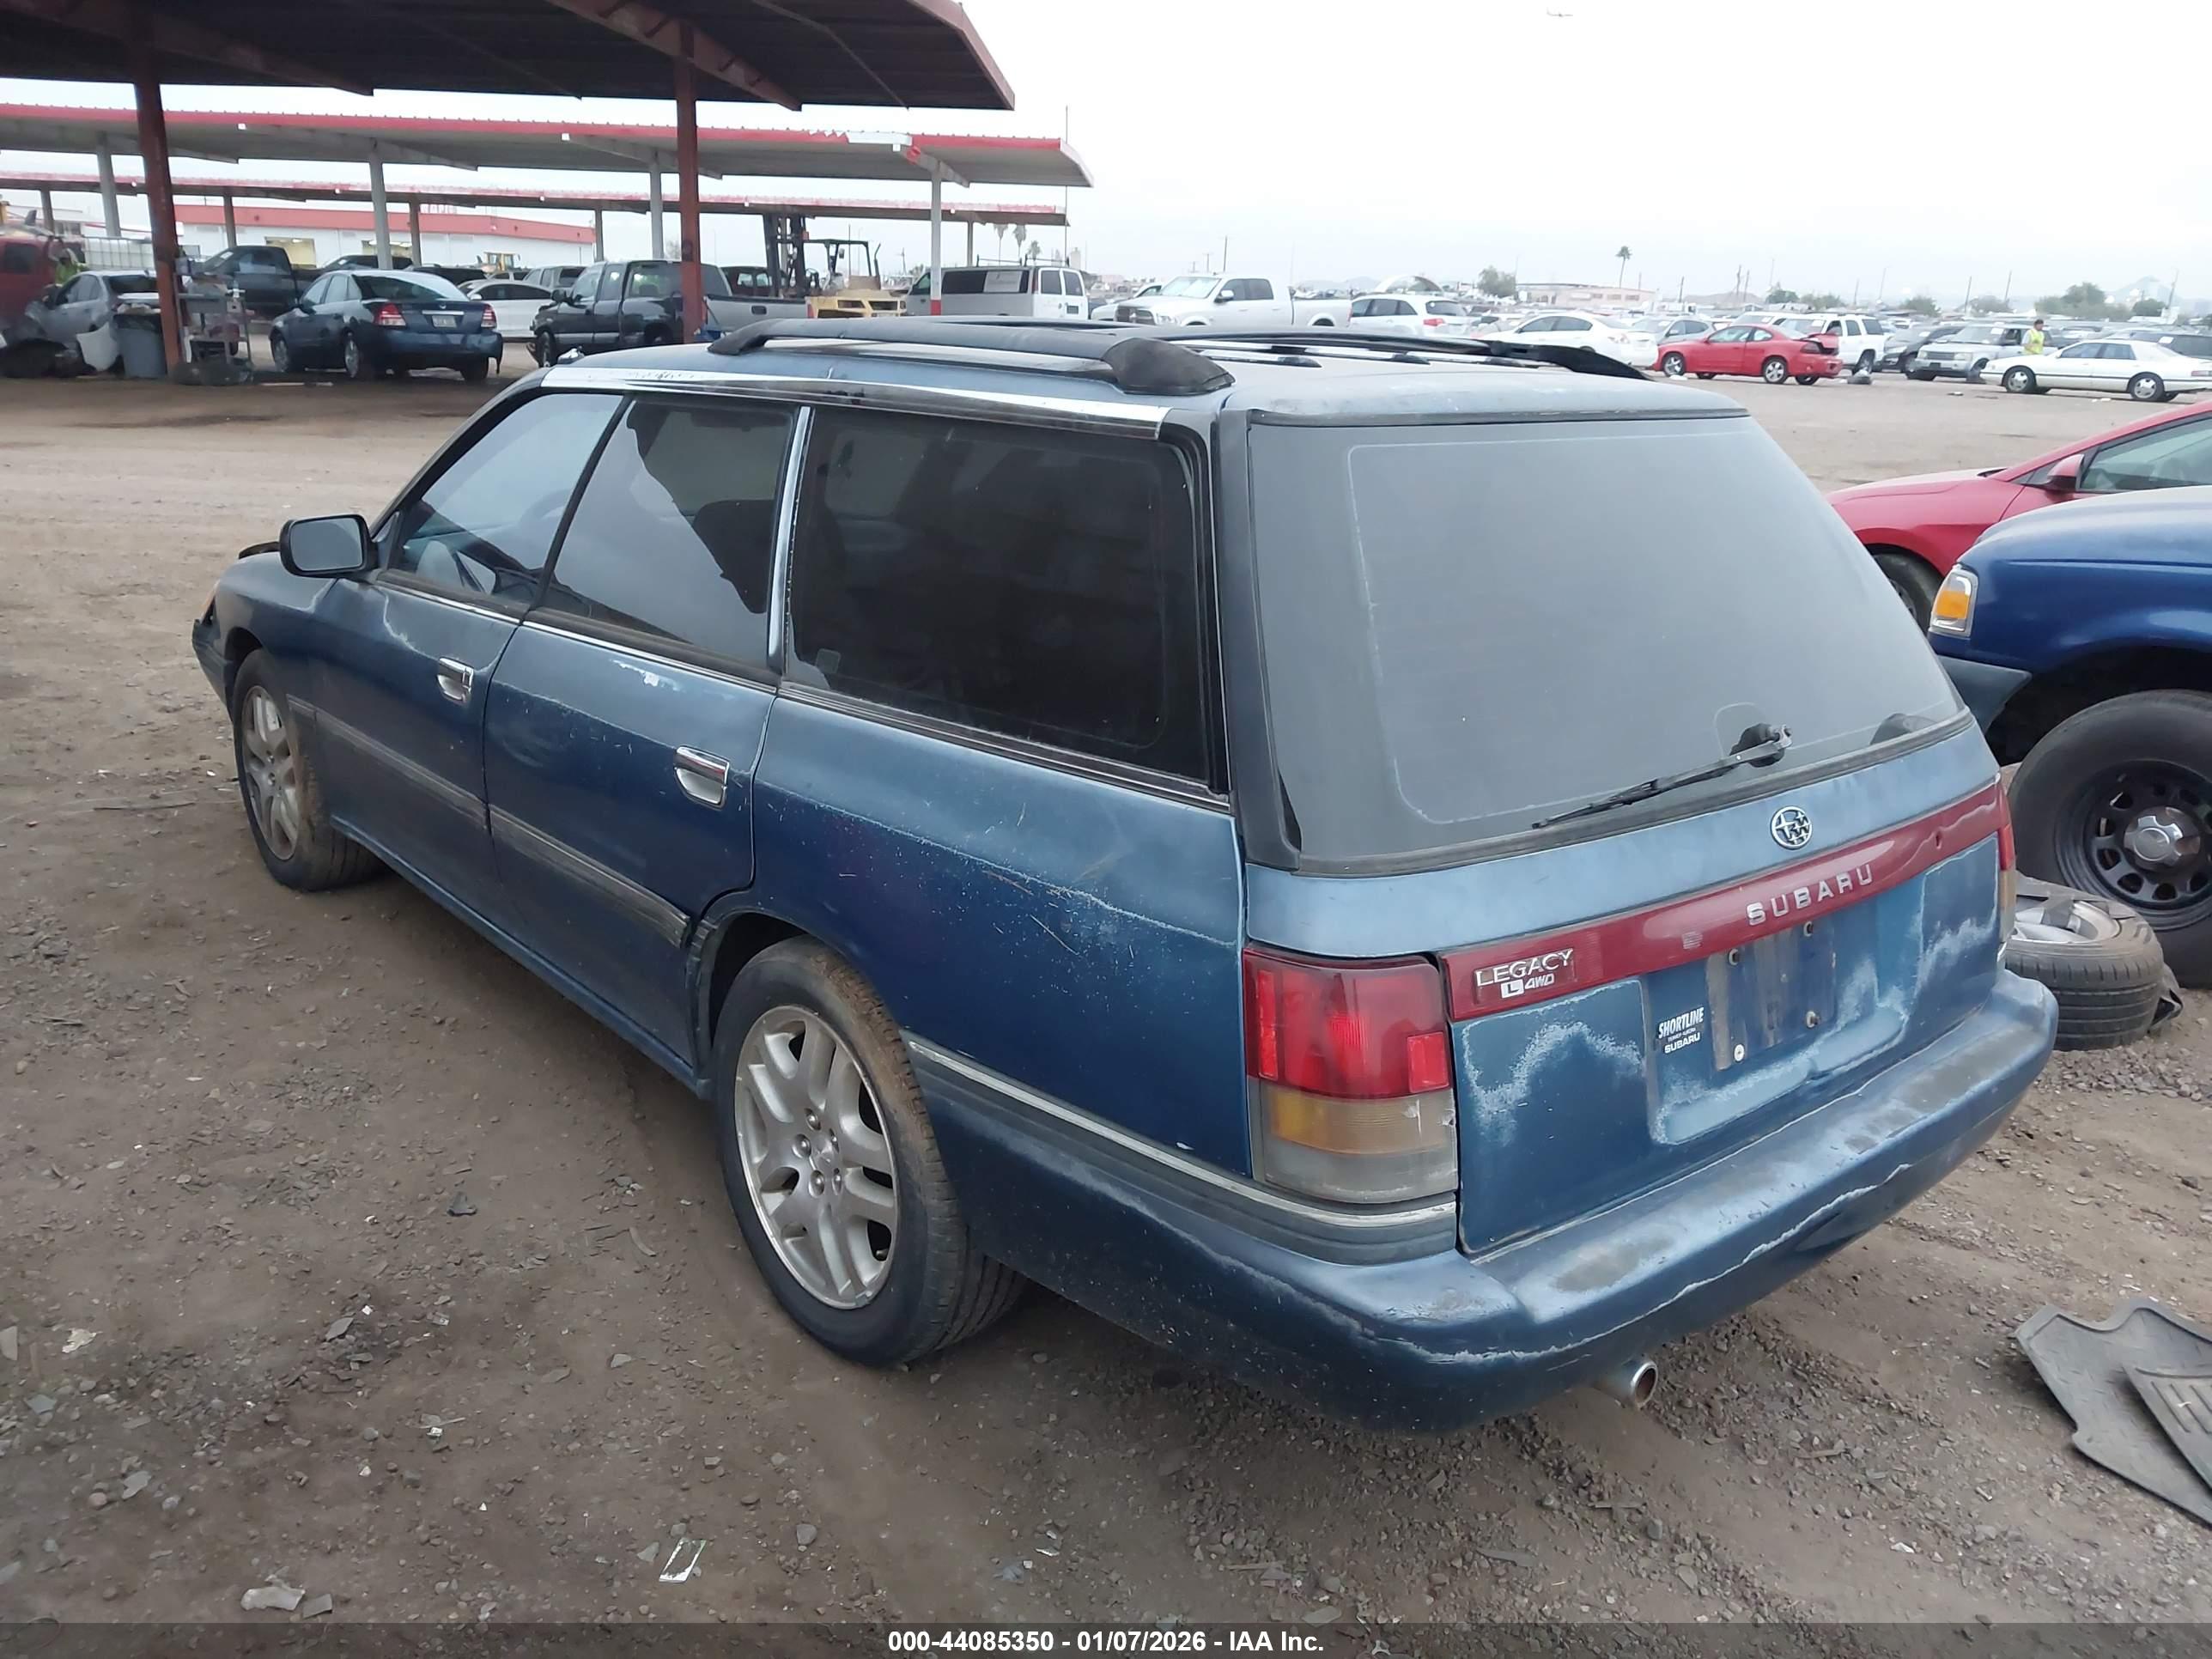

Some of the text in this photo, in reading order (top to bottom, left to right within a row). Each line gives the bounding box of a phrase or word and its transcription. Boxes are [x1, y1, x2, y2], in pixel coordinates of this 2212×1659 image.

[1746, 864, 1874, 926] SUBARU
[1476, 948, 1574, 987] LEGACY
[1504, 973, 1555, 995] L 4WD
[1658, 1006, 1705, 1039] SHORTLINE
[1664, 1032, 1700, 1054] SUBARU
